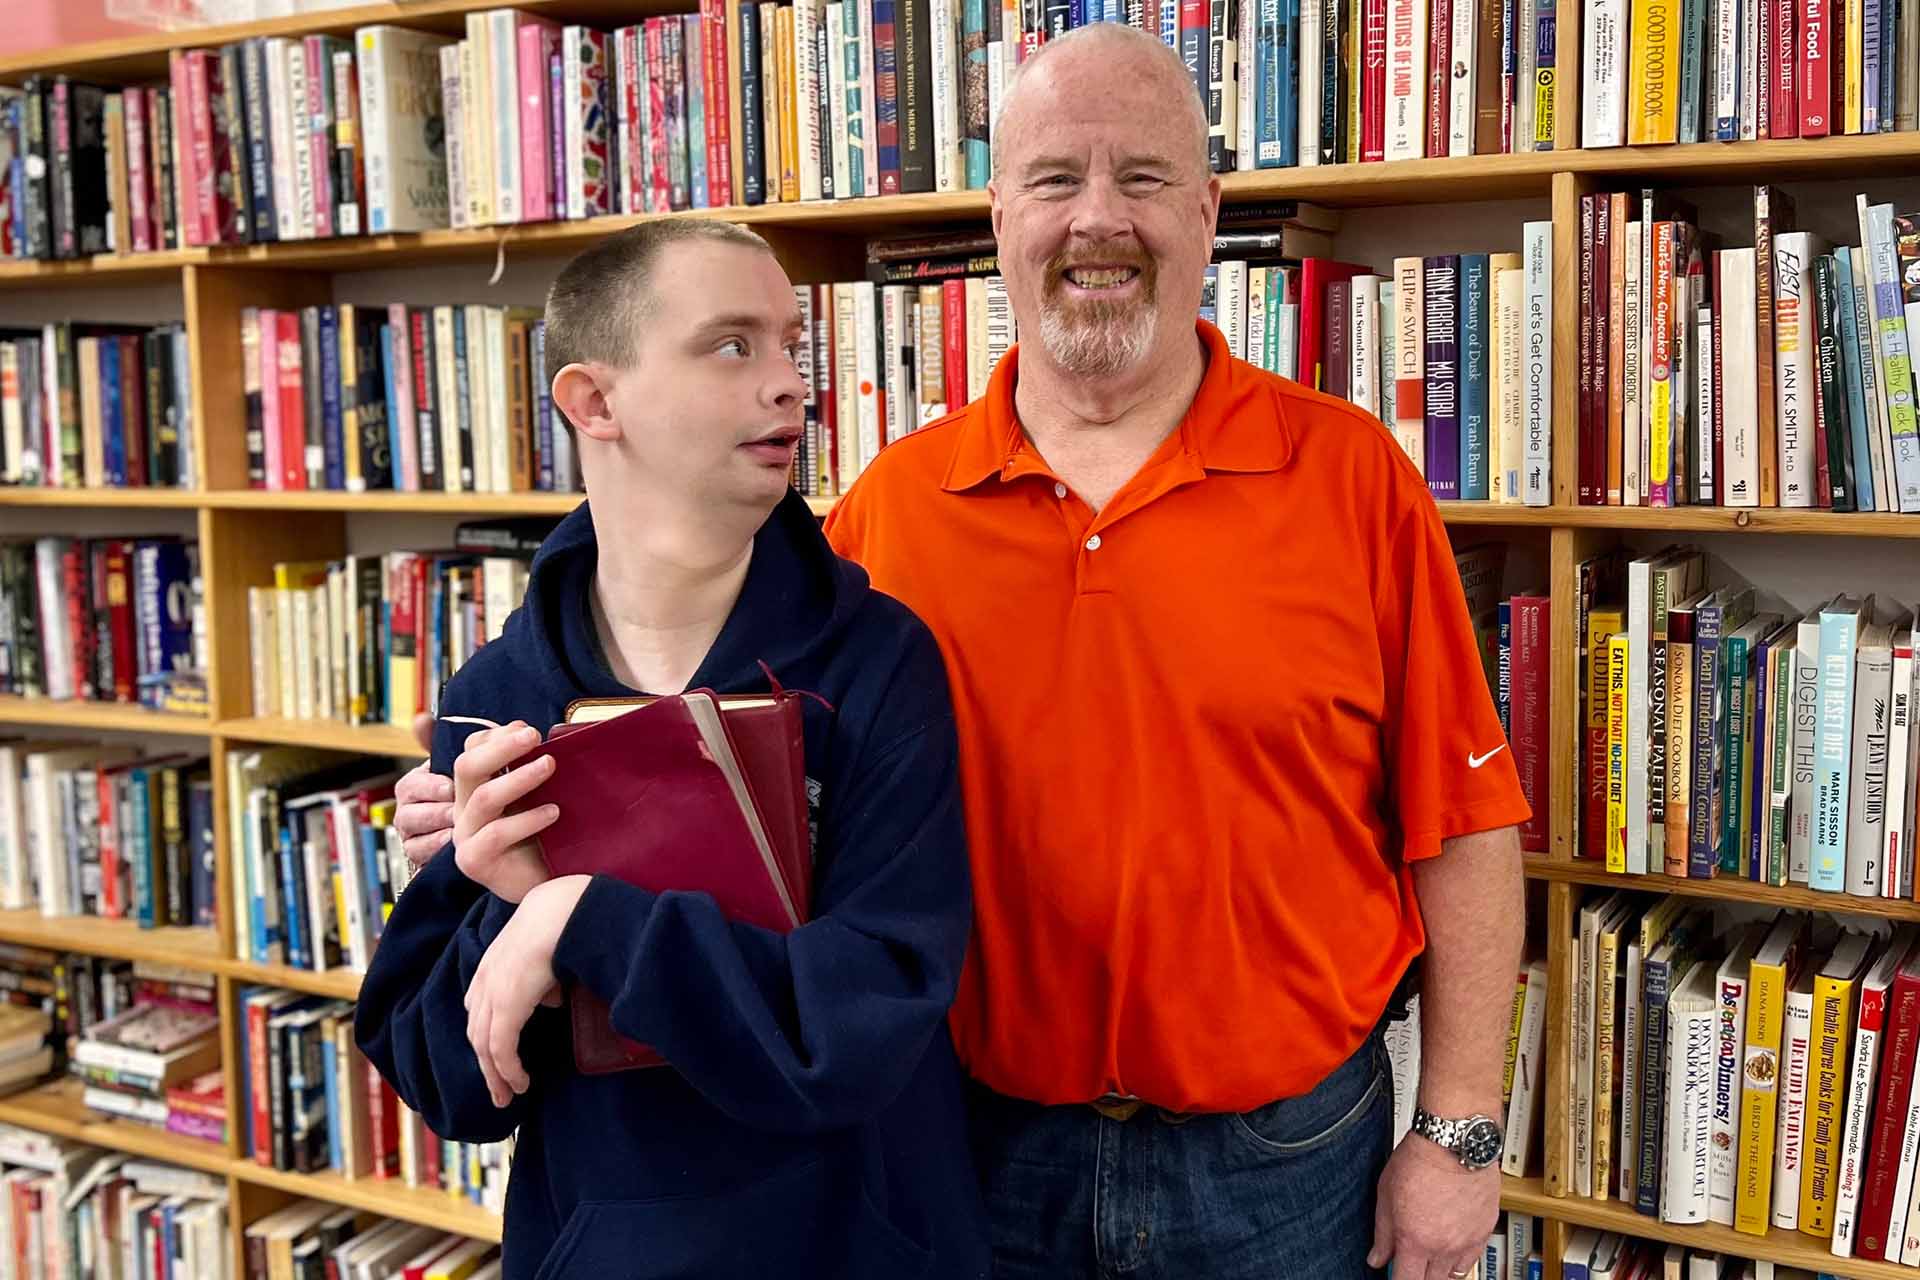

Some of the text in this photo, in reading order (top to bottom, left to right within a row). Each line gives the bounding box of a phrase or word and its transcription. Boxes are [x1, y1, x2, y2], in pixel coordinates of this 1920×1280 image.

[1213, 16, 1222, 31] live
[1367, 13, 1385, 69] THIS
[1782, 2, 1792, 92] REUNION DIET
[907, 64, 915, 106] WITHOUT
[1212, 45, 1221, 79] through
[1394, 66, 1411, 96] LAND
[1395, 50, 1411, 65] OF
[1644, 6, 1666, 119] GOOD FOOD BOOK
[883, 72, 896, 127] BROKAW
[908, 109, 916, 151] MIRRORS
[1546, 86, 1554, 110] USED
[1596, 210, 1608, 246] Poultry
[1656, 224, 1670, 361] What's New, Cupcake?
[1877, 241, 1892, 285] Martha
[988, 296, 1007, 319] WAY
[1332, 286, 1341, 354] SHE STAYS
[1402, 268, 1417, 375] FLIP the SWITCH
[1465, 264, 1481, 381] The Beauty of Dusk
[1776, 250, 1801, 352] FAST BURN
[1820, 269, 1829, 329] WILLIAMS-SONOMA
[923, 304, 940, 389] BUYOUT
[988, 325, 1007, 339] OF
[1356, 295, 1365, 377] That Sounds Fun
[1426, 268, 1455, 418] ANN-MARGRET MY STORY
[1582, 316, 1592, 392] Microwave Magic
[1594, 315, 1605, 392] Microwave Magic
[1626, 280, 1638, 404] THE DESSERTS COOKBOOK
[1820, 336, 1836, 384] Chicken
[1856, 285, 1874, 390] DISCOVER BRUNCH
[1888, 342, 1904, 387] Healthy
[1530, 294, 1544, 451] Let's Get Comfortable
[1784, 364, 1797, 389] IAN
[1784, 392, 1797, 406] K.
[1784, 408, 1798, 454] SMITH,
[1894, 388, 1909, 427] Quick
[1468, 415, 1481, 488] Frank Bruni
[1898, 429, 1914, 463] Cook
[1611, 648, 1624, 804] EAT THIS, NOT THAT! NO-DIET DIET
[1652, 648, 1666, 816] SEASONAL PALETTE
[1671, 650, 1684, 801] SONOMA DIET COOKBOOK
[1694, 646, 1716, 844] Joan Lunden's Healthy Cooking
[1796, 668, 1818, 783] DIGEST THIS
[1818, 786, 1827, 845] BRAD KEARNS
[1828, 772, 1841, 846] MARK SISSON
[1772, 834, 1780, 865] HANSEN
[1756, 980, 1769, 1042] DIANA HENRY
[1624, 1006, 1636, 1139] FABULOUS FOOD THE COSTCO WAY
[1684, 1018, 1699, 1093] COOKBOOK
[1856, 1063, 1870, 1079] Lee
[1858, 1034, 1874, 1062] Sandra
[1640, 1002, 1663, 1188] Joan Lunden's Healthy Cooking
[1694, 1018, 1712, 1200] DON'T EAT YOUR HEART OUT
[1786, 1038, 1808, 1171] HEALTHY EXCHANGES
[1812, 996, 1842, 1201] Nathalie Dupree Cooks for Family and Friends
[1747, 1095, 1761, 1198] A BIRD IN THE HAND
[1903, 1104, 1919, 1163] Mable Hoffman
[1842, 1158, 1856, 1191] cooking
[1844, 1192, 1854, 1200] 2
